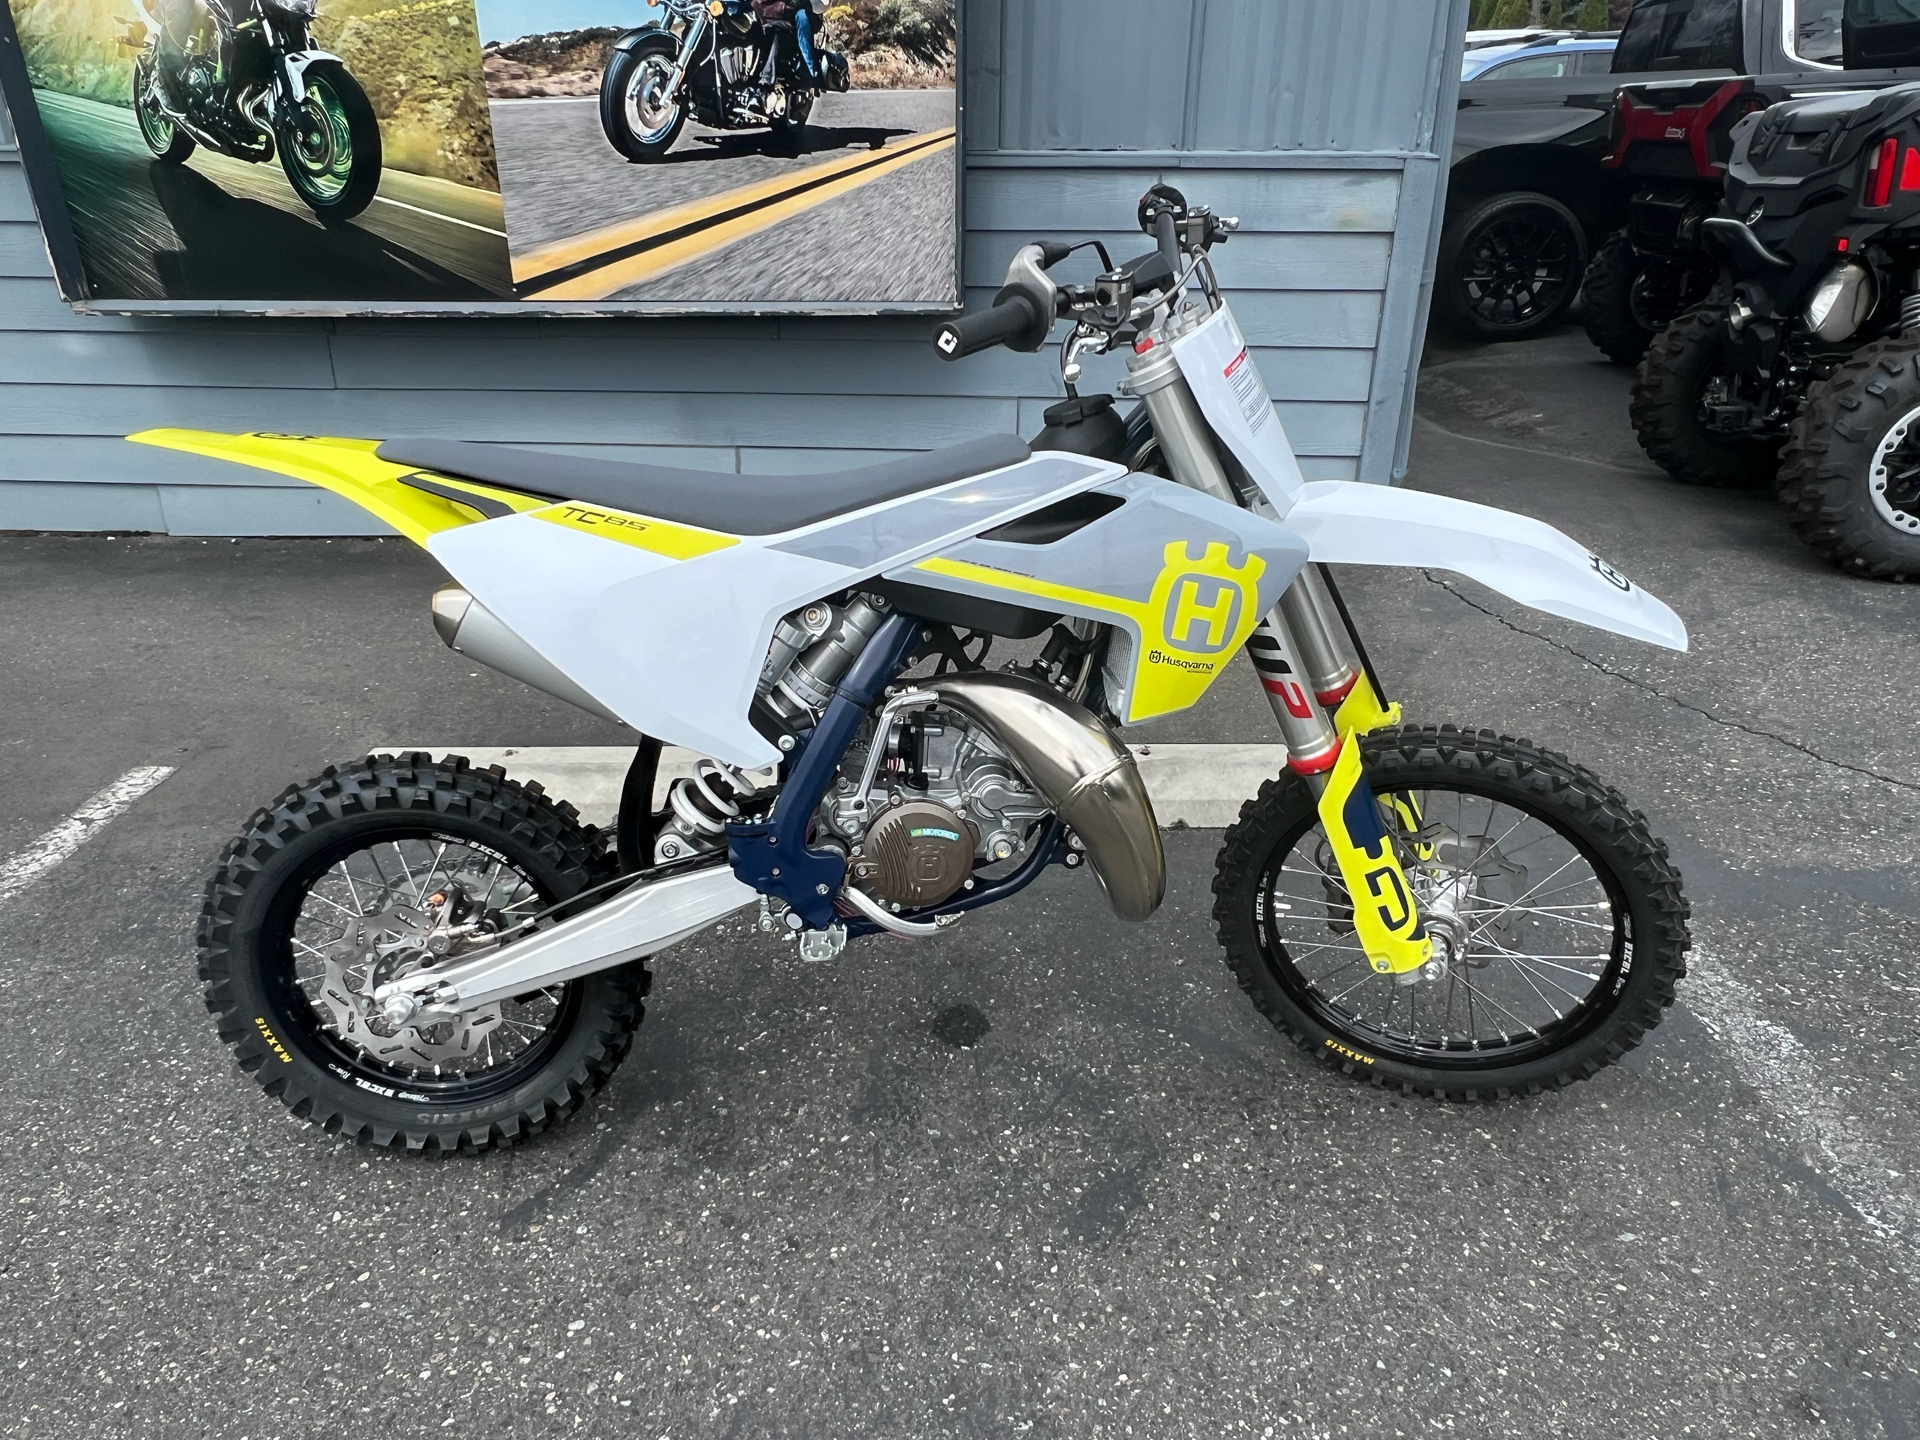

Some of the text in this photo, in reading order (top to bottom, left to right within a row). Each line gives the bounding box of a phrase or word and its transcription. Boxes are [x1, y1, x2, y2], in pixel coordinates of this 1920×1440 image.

[1171, 580, 1235, 646] H
[1162, 655, 1214, 670] Husqvarna
[922, 828, 960, 841] MOTOREX
[469, 841, 509, 864] EXCEL
[1256, 891, 1265, 921] EXCEL
[1619, 941, 1633, 974] EXCEL
[254, 1017, 293, 1063] MAXXIS
[1325, 1039, 1375, 1065] MAXXIS
[355, 1077, 395, 1097] EXCEL
